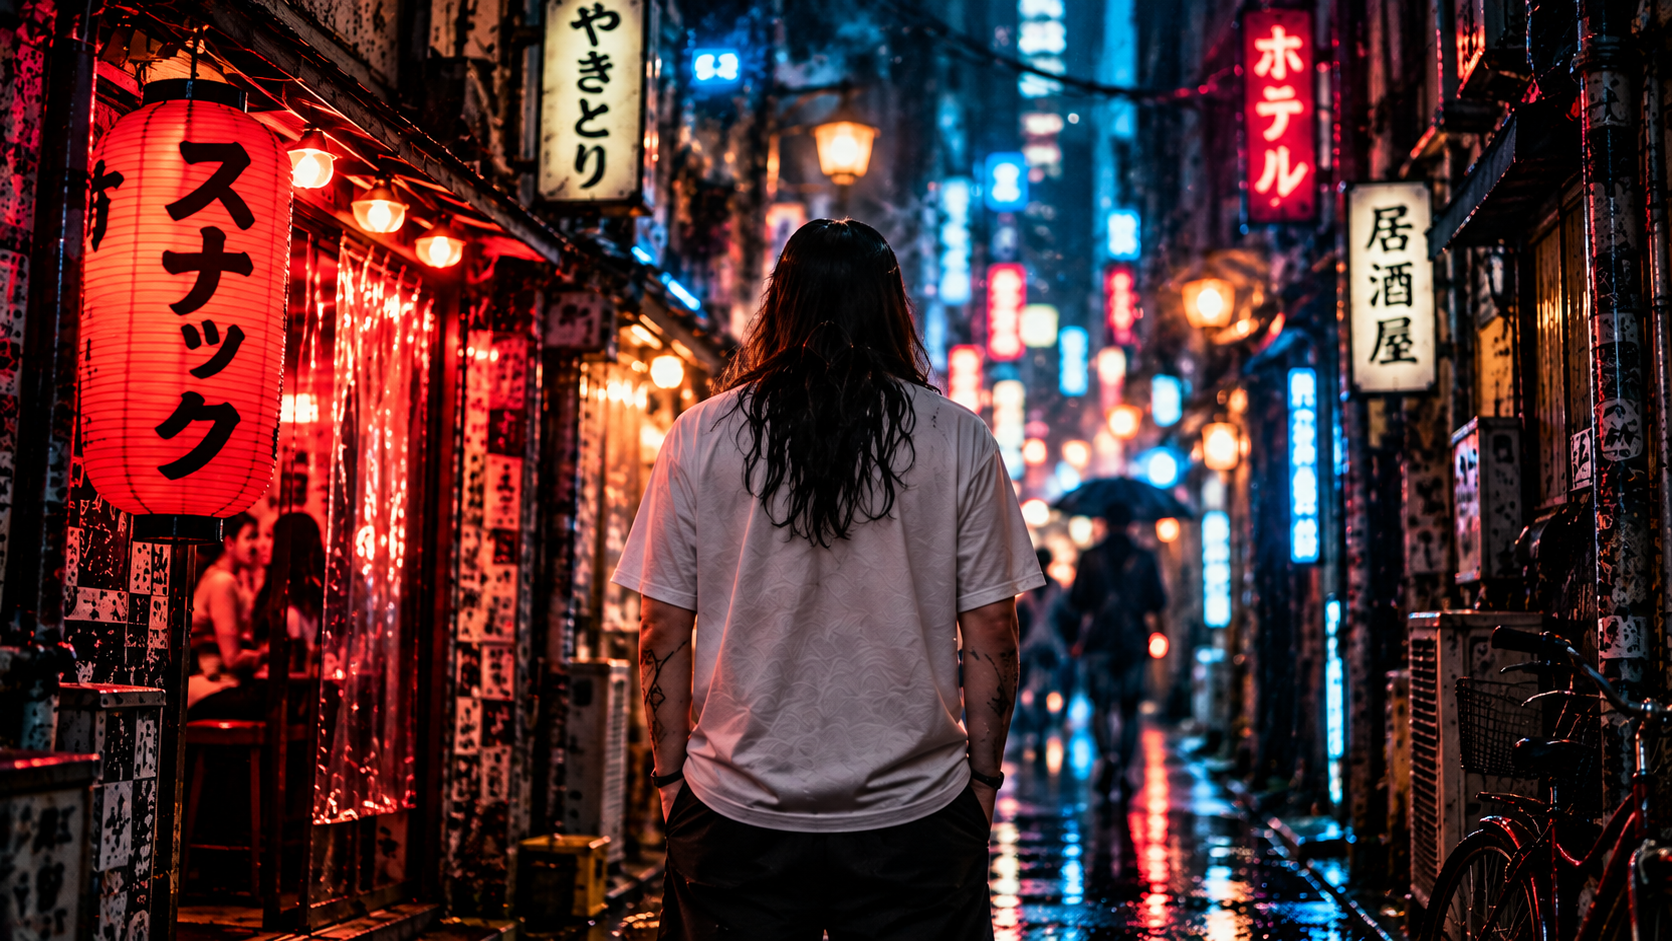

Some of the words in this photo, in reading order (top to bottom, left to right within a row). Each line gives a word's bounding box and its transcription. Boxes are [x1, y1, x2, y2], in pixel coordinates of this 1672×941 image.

[570, 2, 621, 189] やきとり
[1254, 24, 1309, 198] ホテル
[154, 140, 256, 481] スナック
[1366, 204, 1419, 366] 居酒屋
